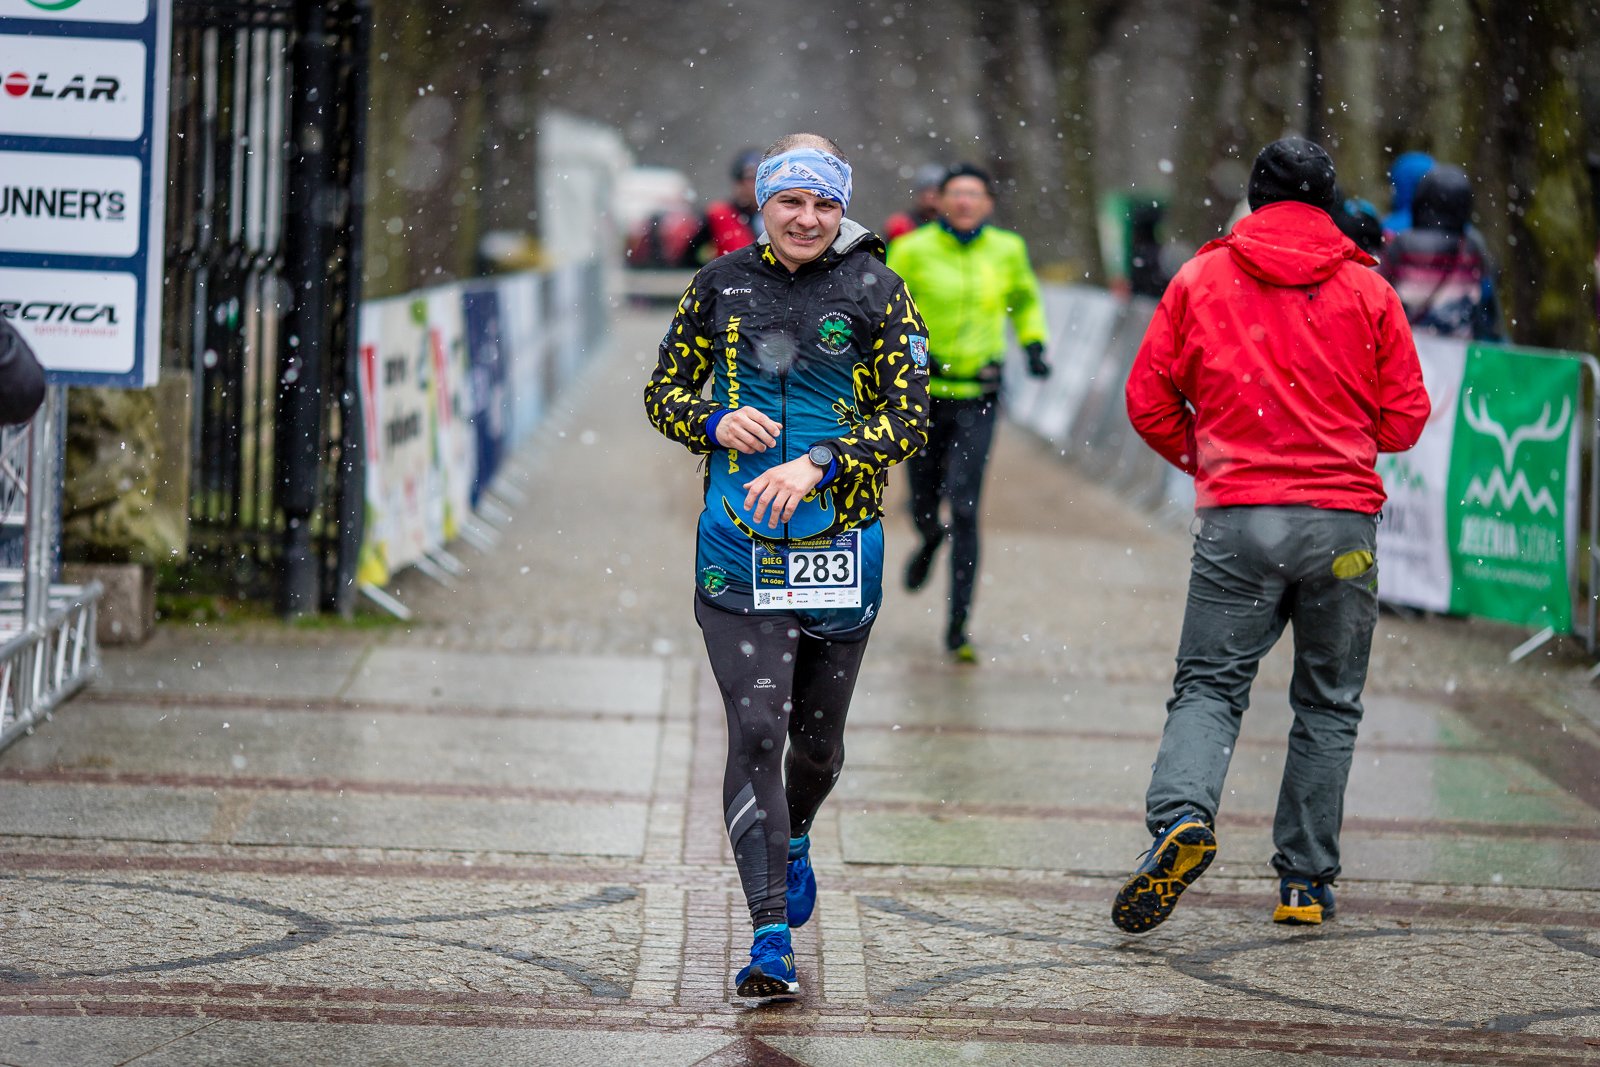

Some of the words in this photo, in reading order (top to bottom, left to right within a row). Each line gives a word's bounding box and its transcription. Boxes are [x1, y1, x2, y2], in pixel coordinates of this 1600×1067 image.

[0, 73, 119, 102] OLAR
[726, 315, 742, 344] JKS
[725, 347, 741, 474] SALAMRA
[761, 557, 783, 565] BIEG
[793, 553, 850, 583] 283
